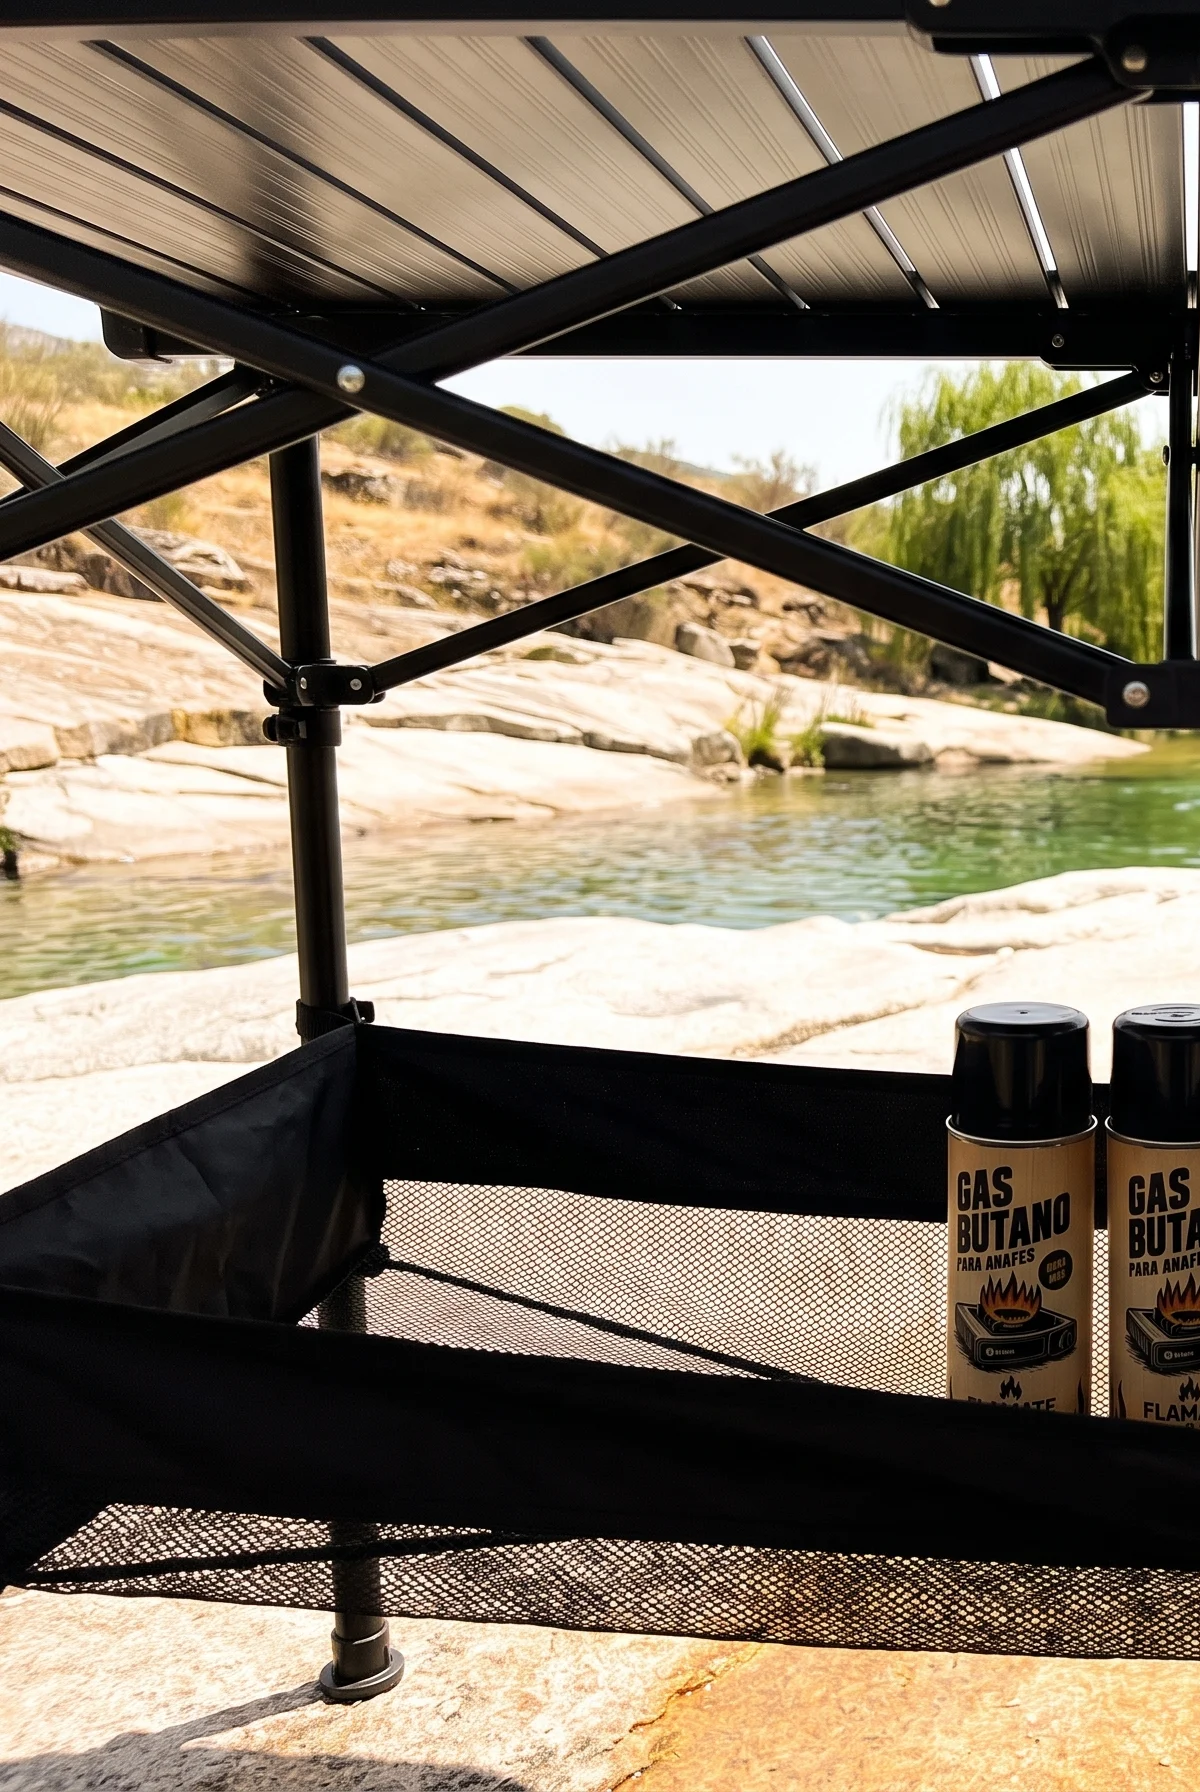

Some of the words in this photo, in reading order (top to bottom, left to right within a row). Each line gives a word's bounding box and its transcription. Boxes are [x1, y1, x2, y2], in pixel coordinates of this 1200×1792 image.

[957, 1166, 1013, 1212] GAS
[1129, 1167, 1190, 1216] GAS
[957, 1192, 1071, 1254] BUTANO
[957, 1256, 982, 1272] PARA
[985, 1247, 1036, 1271] ANAFES
[1129, 1260, 1158, 1277] PARA
